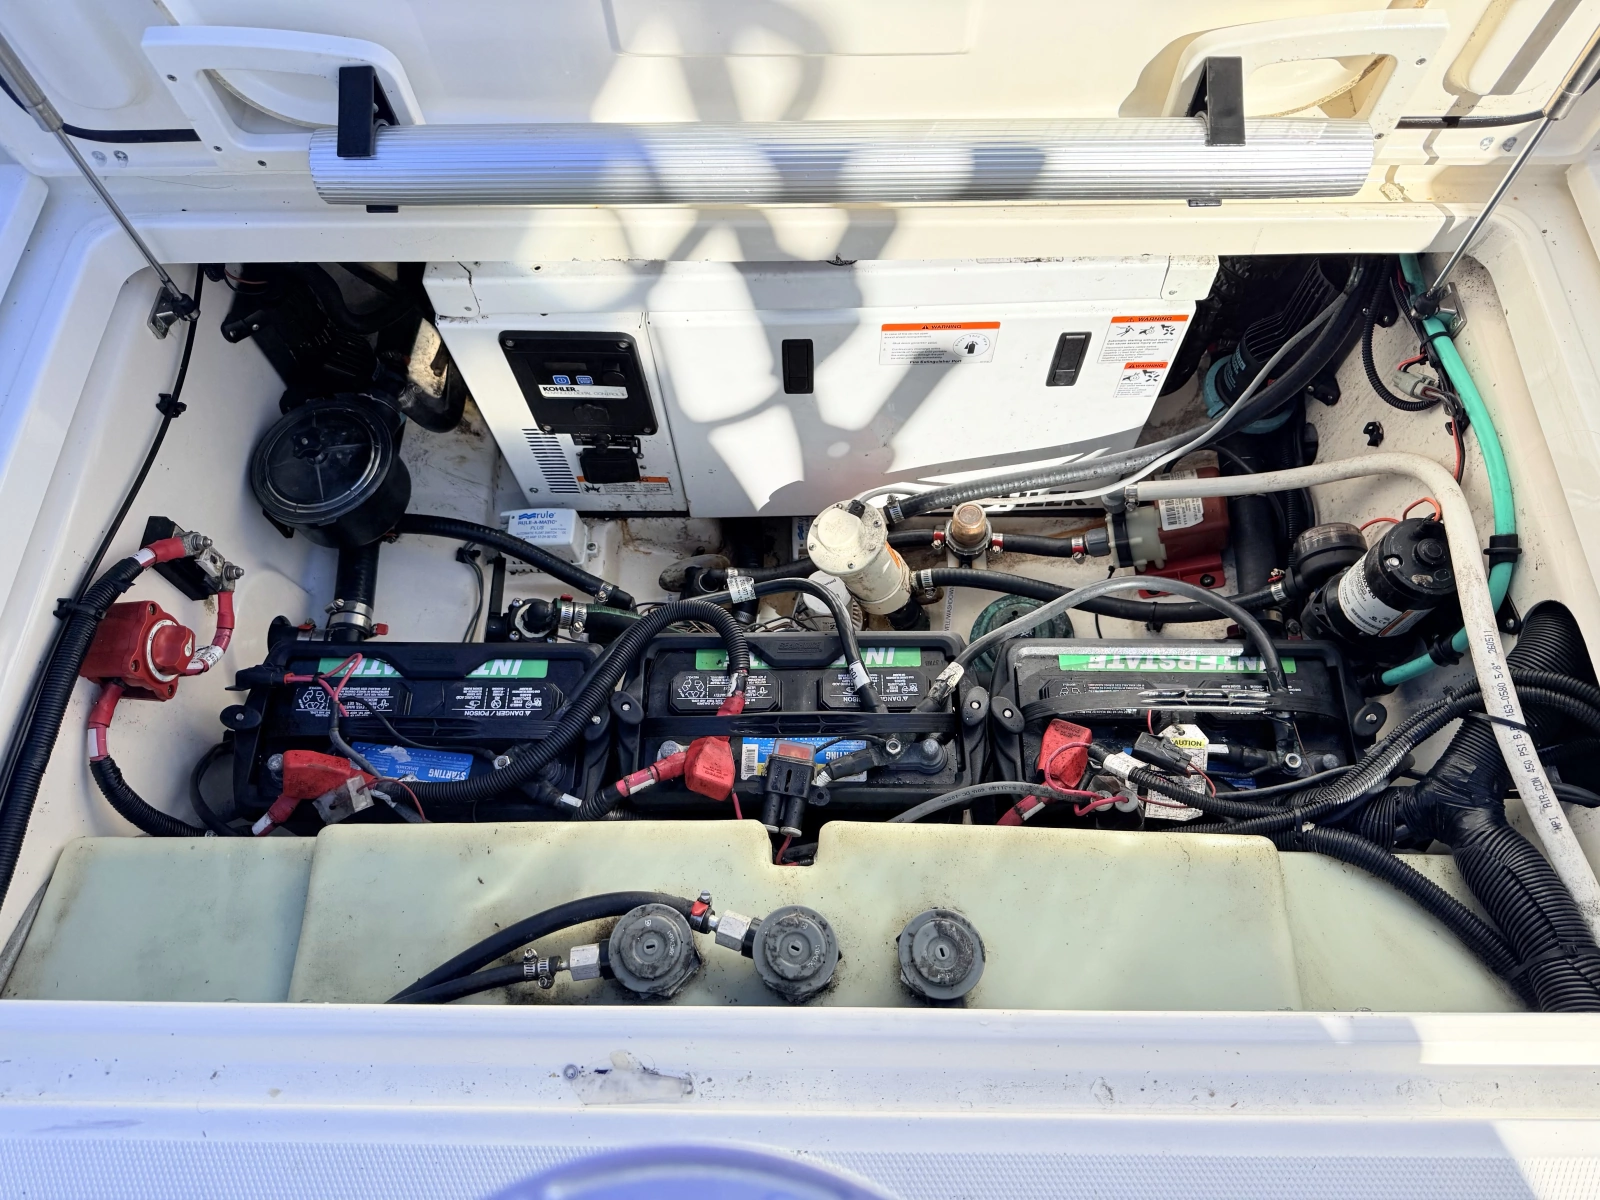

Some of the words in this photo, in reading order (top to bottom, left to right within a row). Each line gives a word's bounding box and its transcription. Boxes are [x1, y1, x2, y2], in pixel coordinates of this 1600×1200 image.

[536, 510, 554, 519] rule
[1483, 629, 1497, 654] 260511
[1491, 662, 1504, 679] 5/8"
[1497, 682, 1515, 718] 163-0580
[1516, 743, 1530, 756] PSI
[428, 768, 466, 780] STARTING
[1524, 760, 1536, 773] 450
[1530, 776, 1553, 809] AIR-CON
